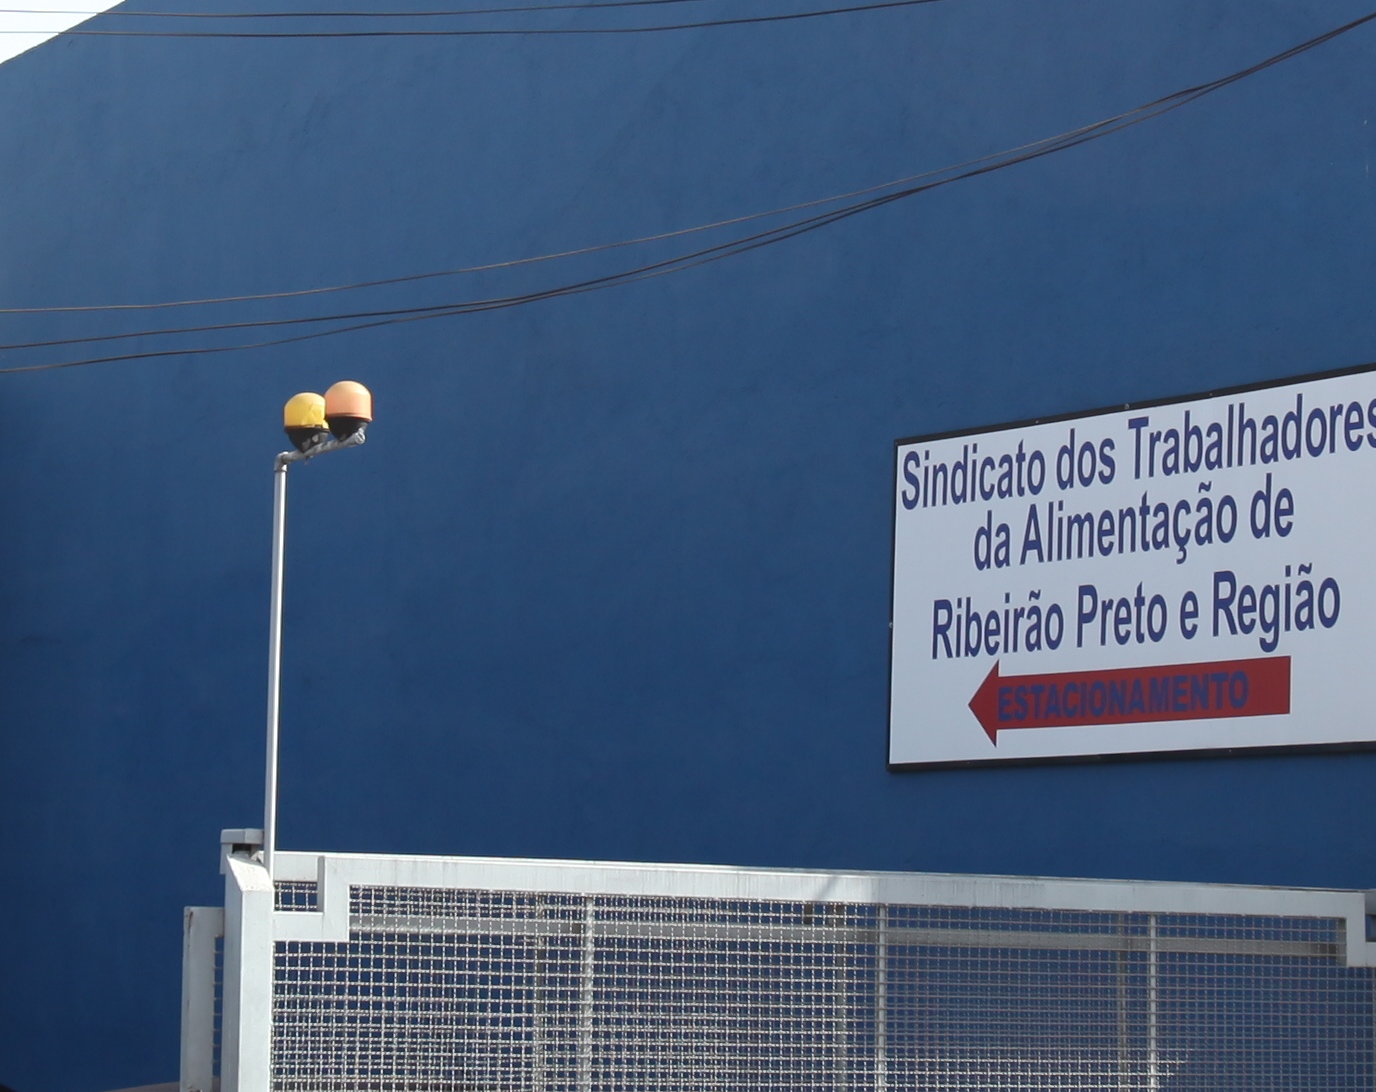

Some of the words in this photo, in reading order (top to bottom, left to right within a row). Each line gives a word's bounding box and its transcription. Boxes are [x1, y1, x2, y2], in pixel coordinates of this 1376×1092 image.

[902, 437, 1046, 510] Sindicato
[1056, 428, 1116, 491] dos
[975, 509, 1011, 571] da
[1019, 481, 1238, 566] Alimentação
[1250, 472, 1295, 539] de
[931, 589, 1065, 660] Ribeirão
[1076, 581, 1168, 648] Preto
[1179, 590, 1200, 640] e
[1212, 562, 1341, 653] Região
[997, 670, 1250, 722] ESTACIONAMENTO
